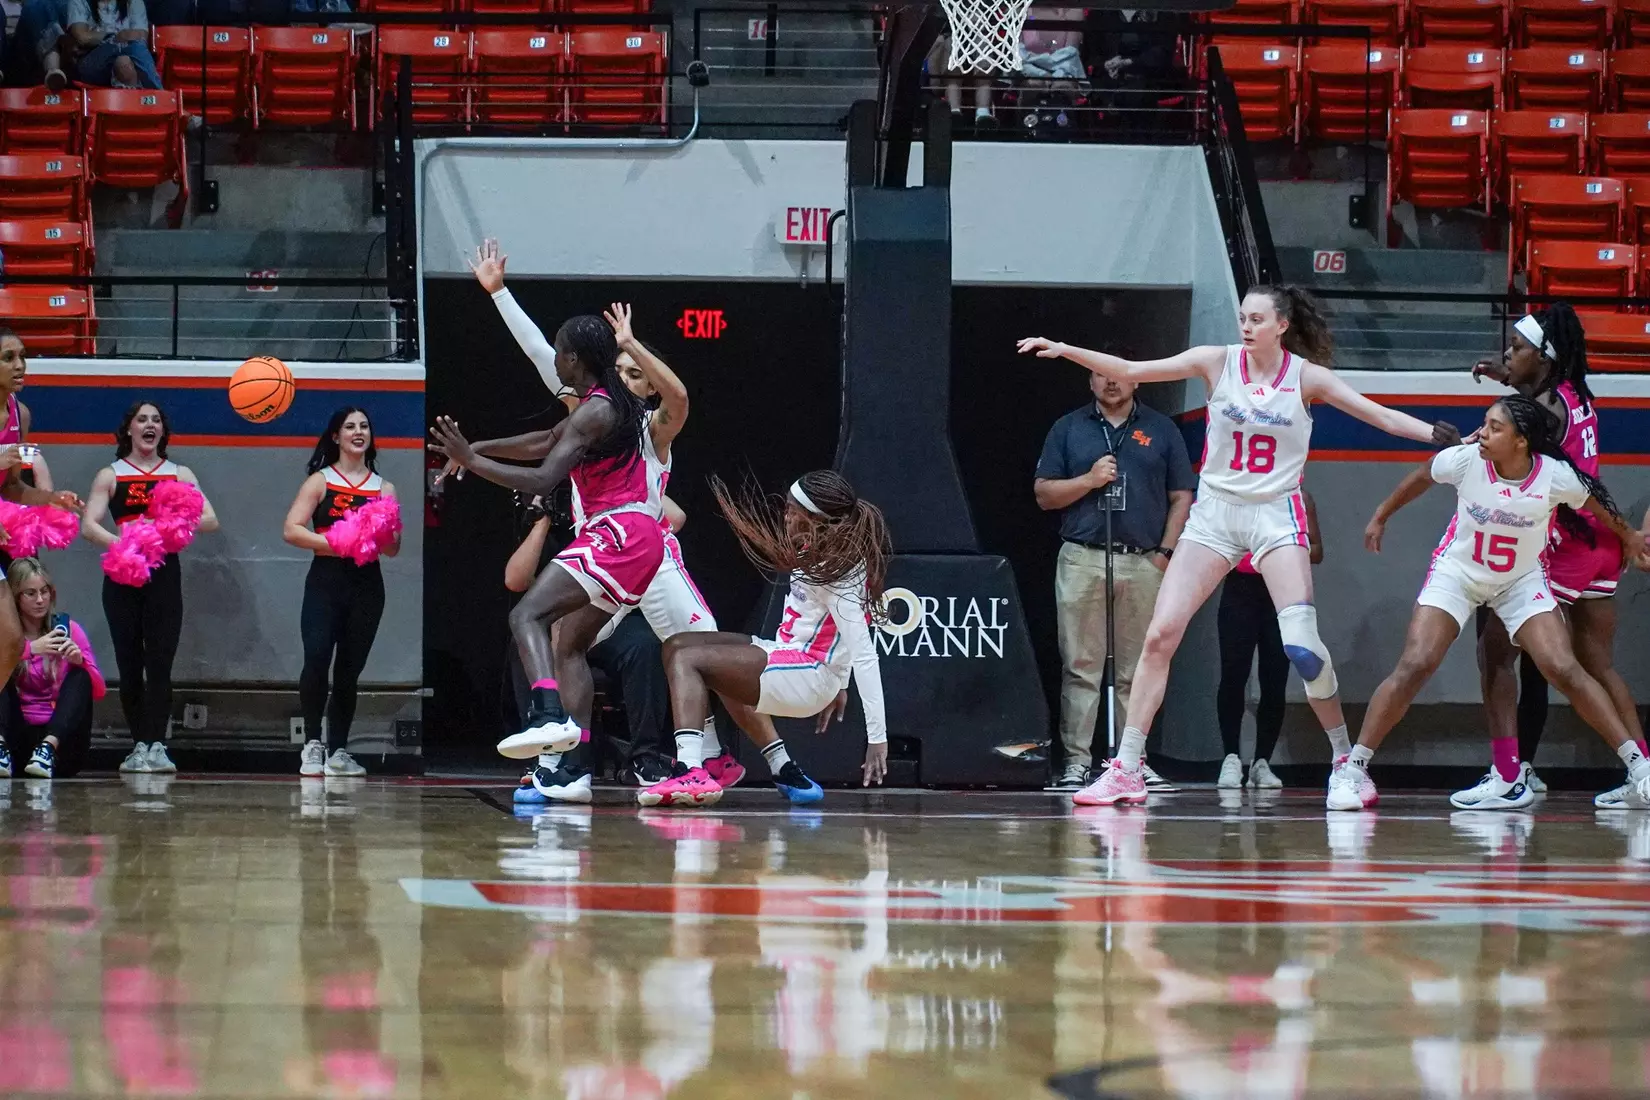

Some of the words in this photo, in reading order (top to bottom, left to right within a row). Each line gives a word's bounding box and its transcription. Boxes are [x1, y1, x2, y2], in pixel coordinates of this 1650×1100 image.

[786, 207, 831, 241] EXIT
[1314, 251, 1345, 271] 06
[684, 309, 724, 339] EXIT
[1229, 431, 1277, 474] 18
[1472, 531, 1518, 572] 15
